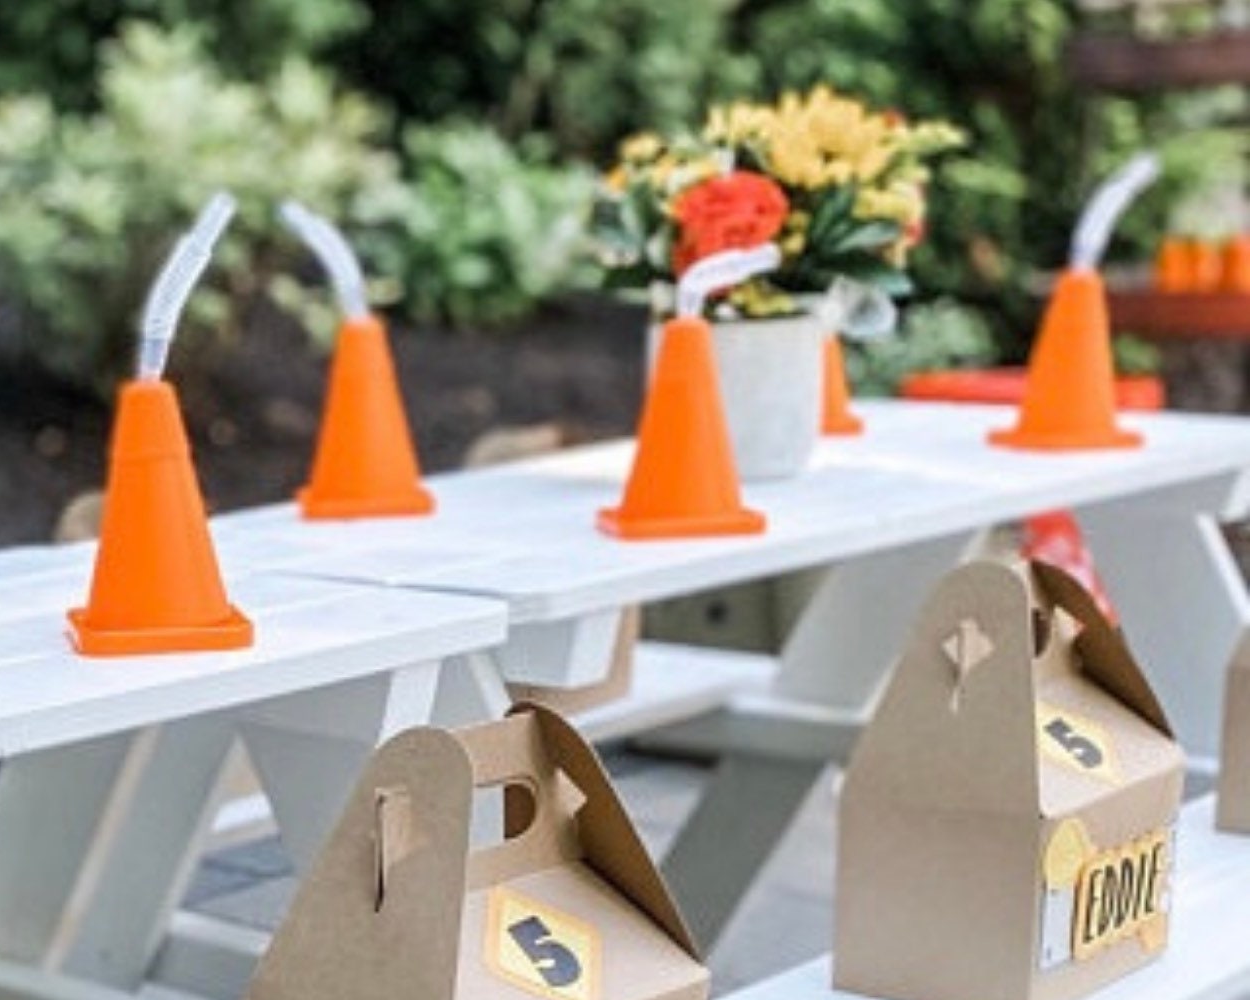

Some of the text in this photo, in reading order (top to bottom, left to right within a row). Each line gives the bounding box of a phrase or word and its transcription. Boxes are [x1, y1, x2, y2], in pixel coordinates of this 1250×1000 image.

[1044, 717, 1103, 768] 5
[1082, 842, 1164, 944] EDDIE
[507, 915, 582, 988] 5
